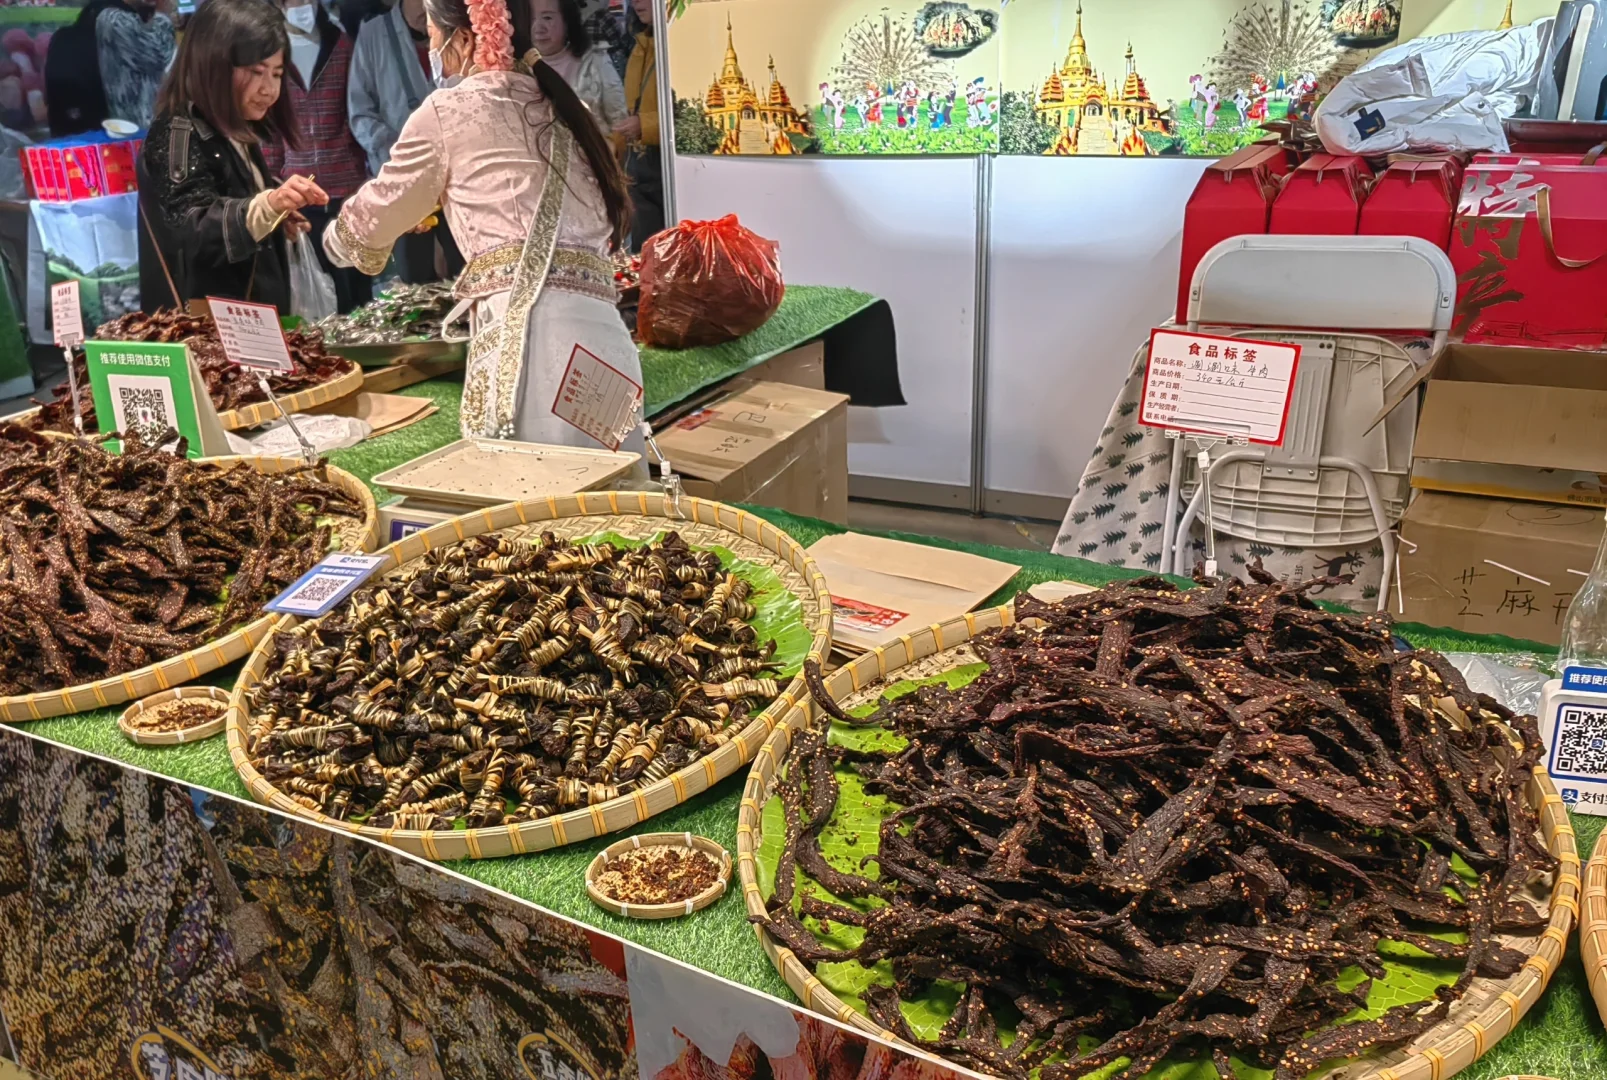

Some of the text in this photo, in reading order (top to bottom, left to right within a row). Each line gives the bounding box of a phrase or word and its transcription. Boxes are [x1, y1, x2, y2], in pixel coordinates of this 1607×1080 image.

[100, 352, 171, 367] 推荐使用微信支付
[1188, 342, 1258, 363] 食品标签
[1579, 791, 1607, 805] 支付
